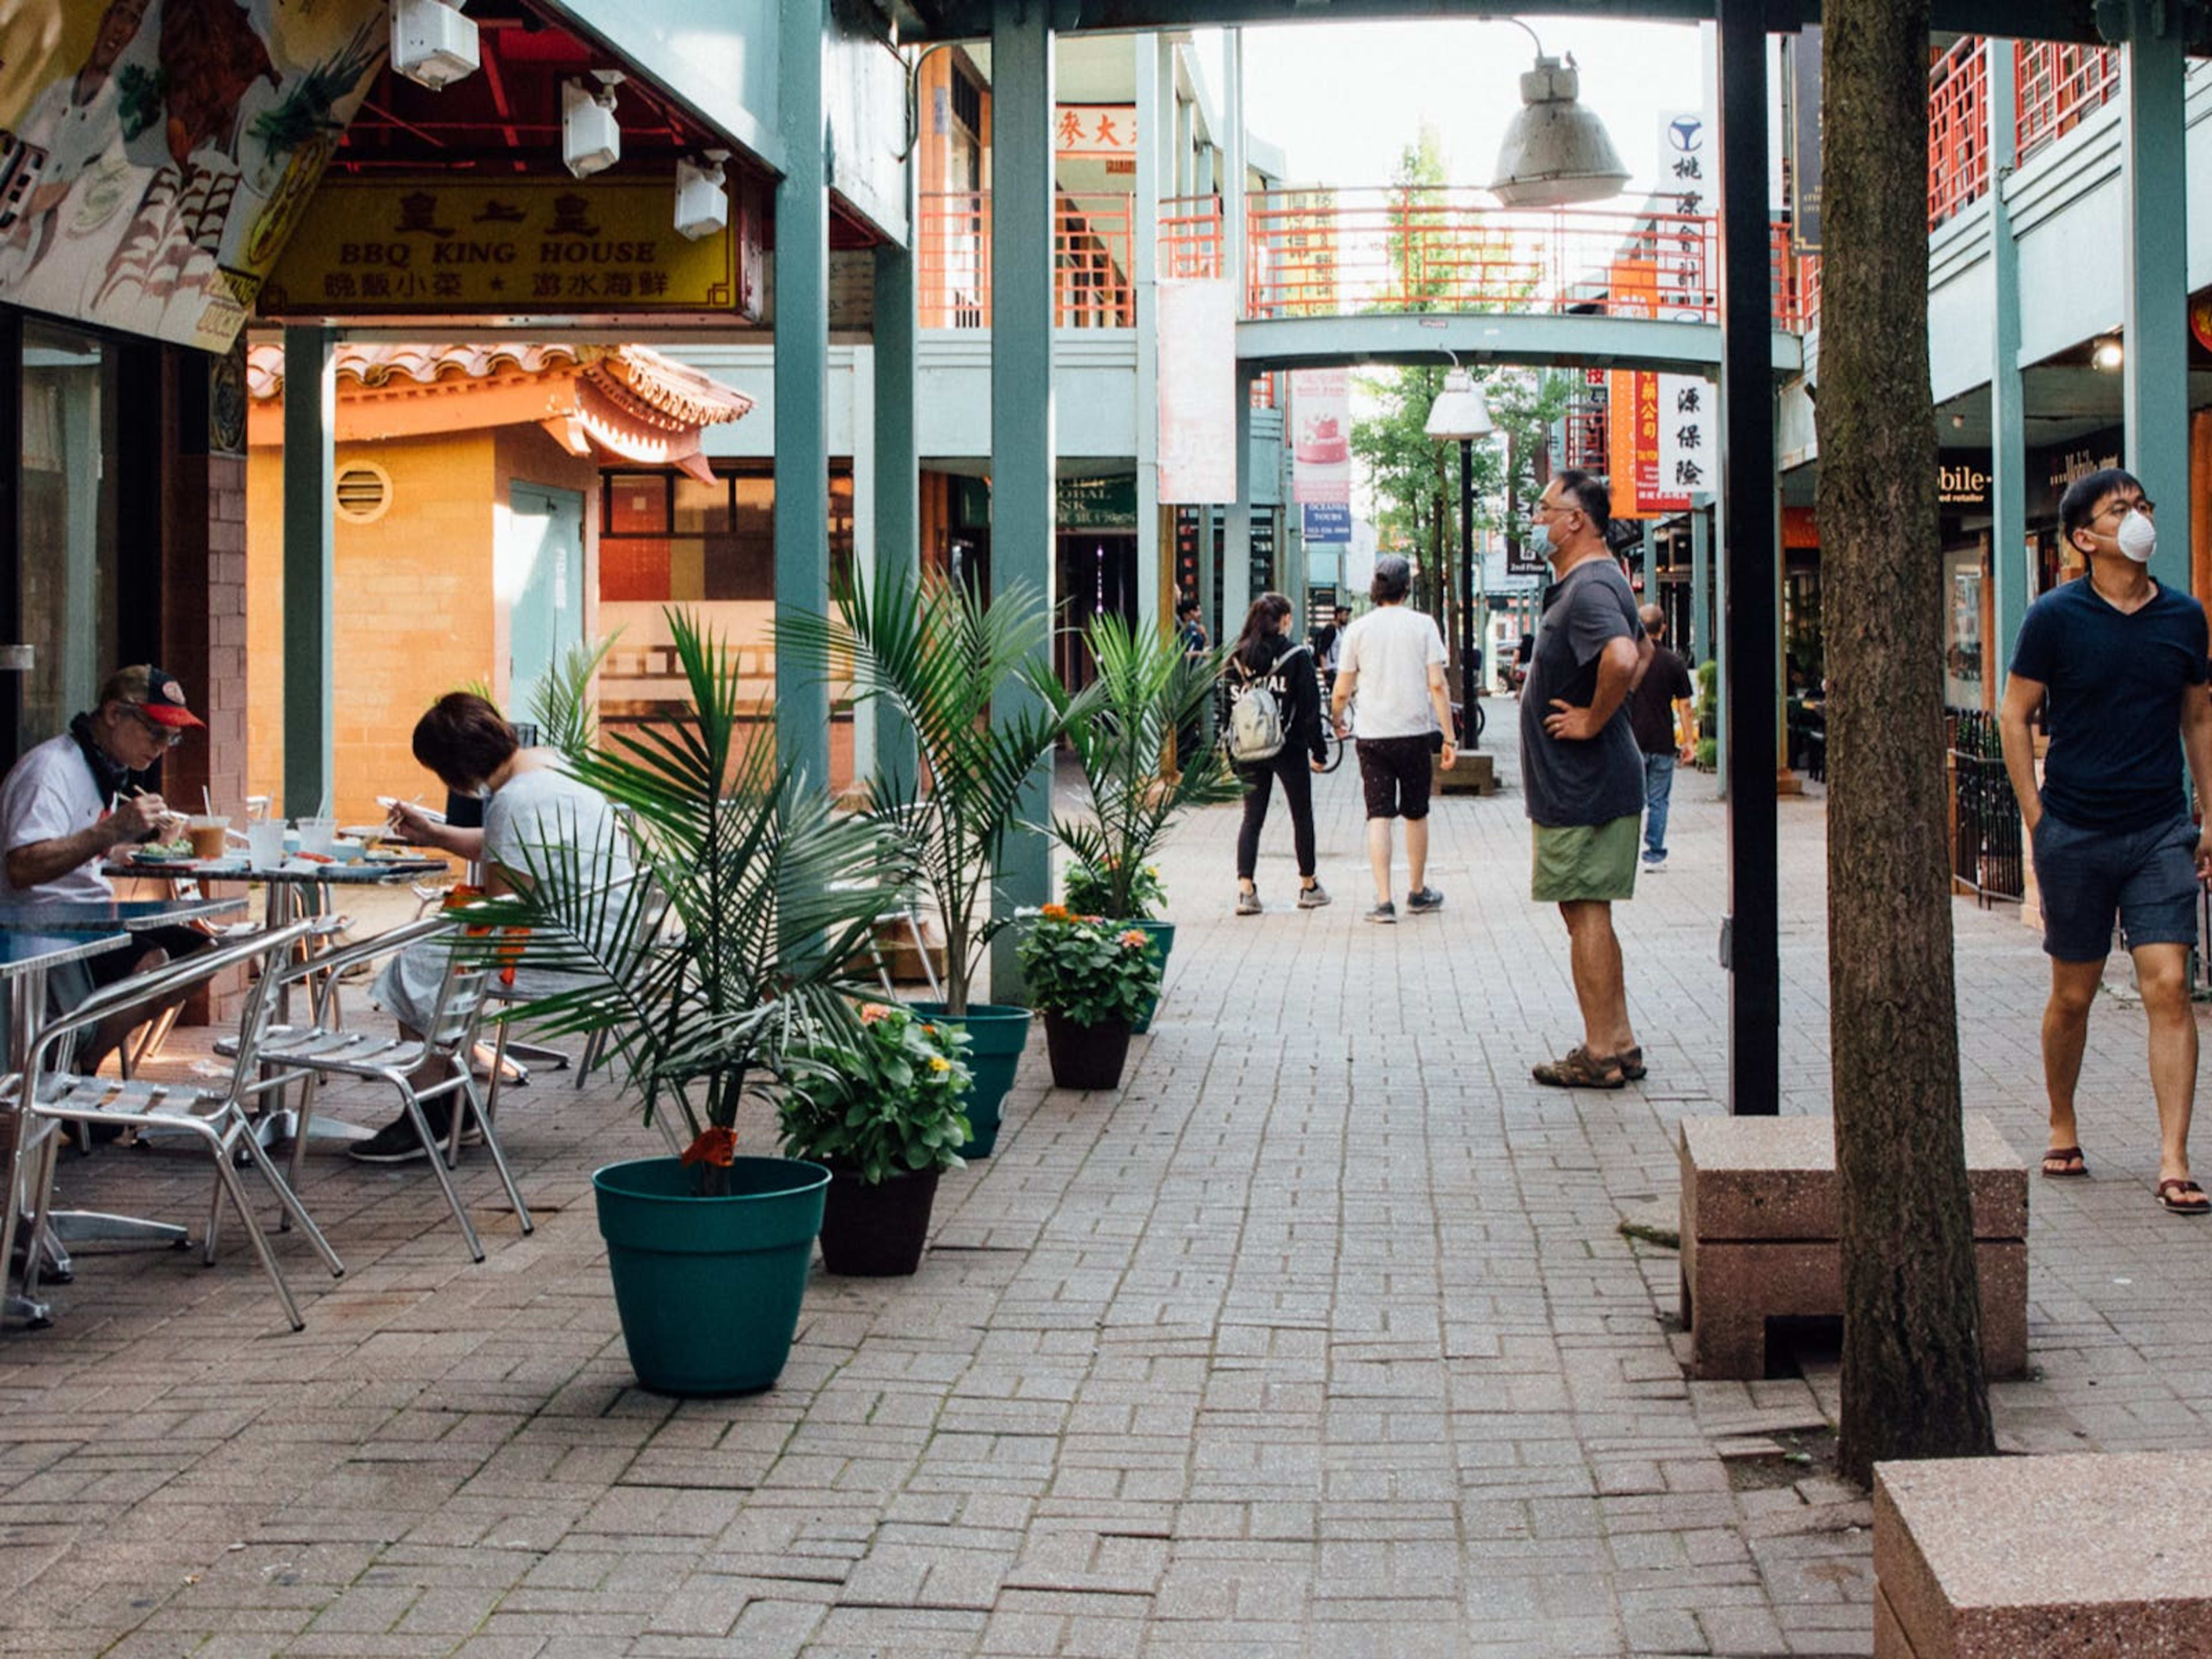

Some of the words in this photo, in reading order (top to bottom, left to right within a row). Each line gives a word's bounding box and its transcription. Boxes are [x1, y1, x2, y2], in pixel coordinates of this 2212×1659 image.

[395, 192, 599, 237] 皇上皇
[340, 243, 411, 268] BBQ
[432, 243, 517, 264] KING
[541, 242, 656, 264] HOUSE
[1676, 387, 1704, 486] 源保險
[1936, 466, 1985, 491] bile
